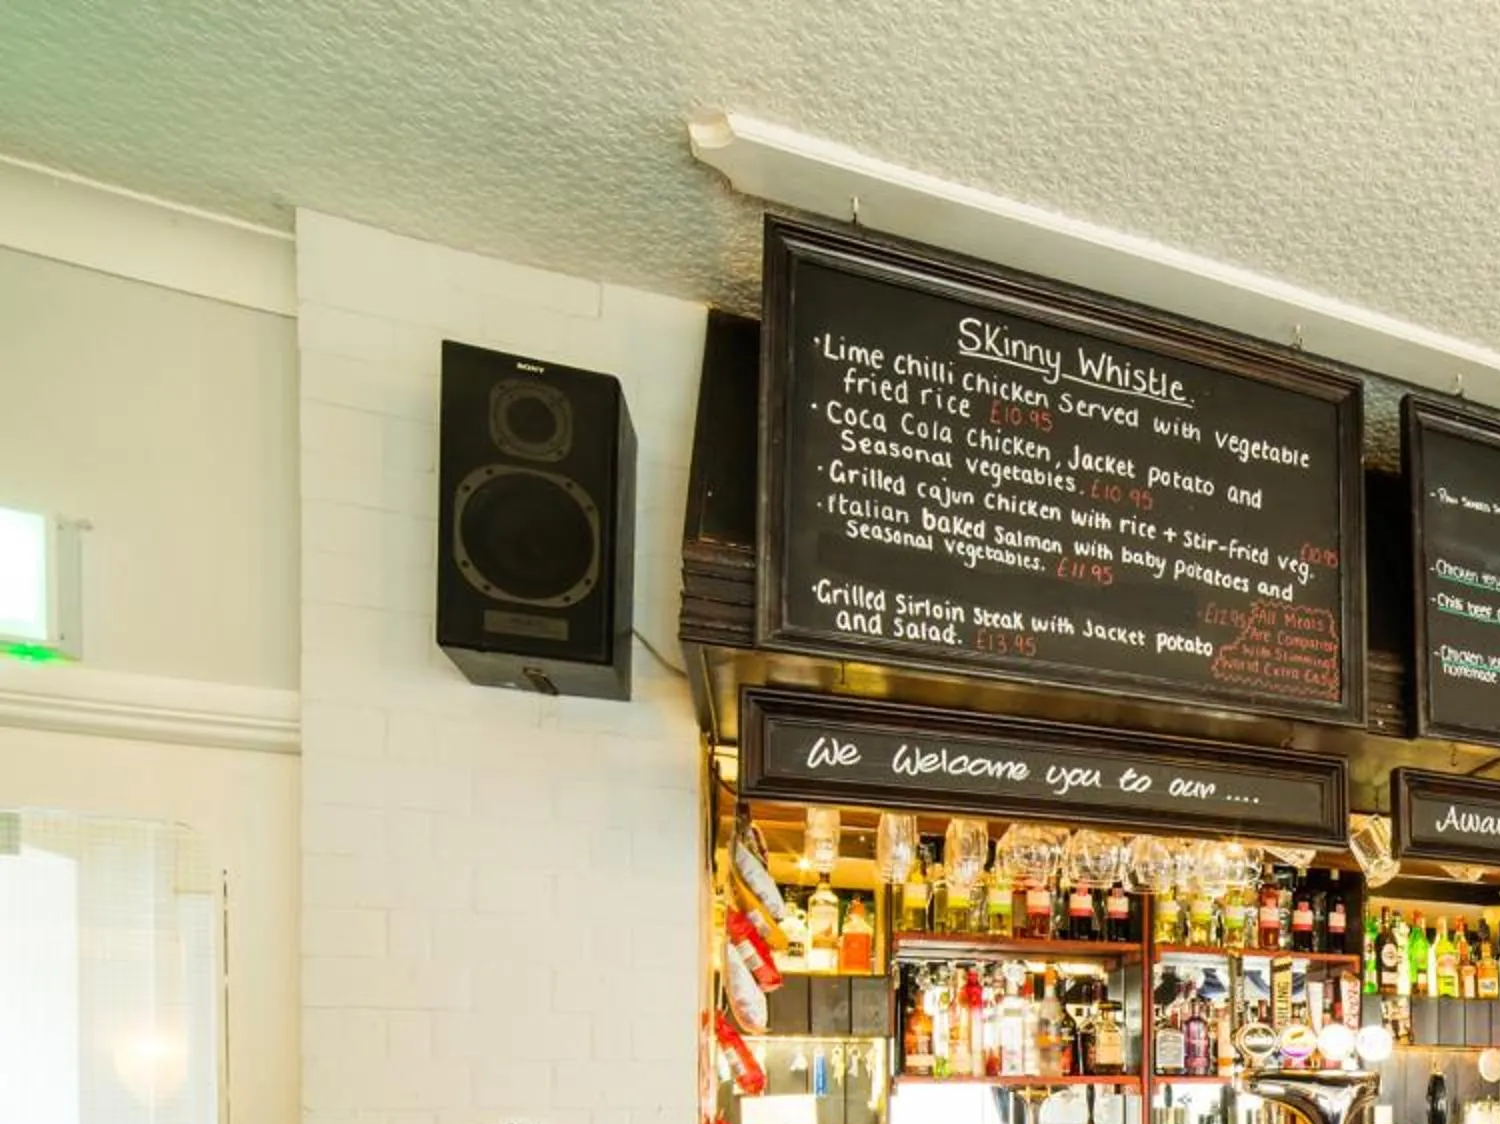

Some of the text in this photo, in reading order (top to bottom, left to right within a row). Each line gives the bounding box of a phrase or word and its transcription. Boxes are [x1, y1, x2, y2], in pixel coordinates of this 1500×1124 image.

[824, 333, 884, 370] Lime
[1153, 416, 1201, 442] with
[1215, 430, 1310, 469] vegetable
[844, 367, 909, 405] fried
[921, 387, 971, 419] rice
[826, 400, 887, 433] Coca
[901, 412, 953, 445] Cola
[1228, 485, 1263, 510] and
[829, 459, 907, 497] Grilled
[1071, 507, 1112, 531] with
[1120, 515, 1157, 541] rice
[828, 493, 910, 525] Italian
[1074, 540, 1114, 562] with
[1122, 546, 1168, 579] baby
[1174, 559, 1250, 594] potatoes
[1257, 580, 1294, 601] and
[817, 578, 886, 612] Grilled
[1031, 615, 1075, 635] with
[836, 610, 882, 635] and
[807, 737, 862, 769] We
[892, 744, 1030, 781] Welcome
[1046, 765, 1101, 795] you
[1119, 769, 1150, 794] to
